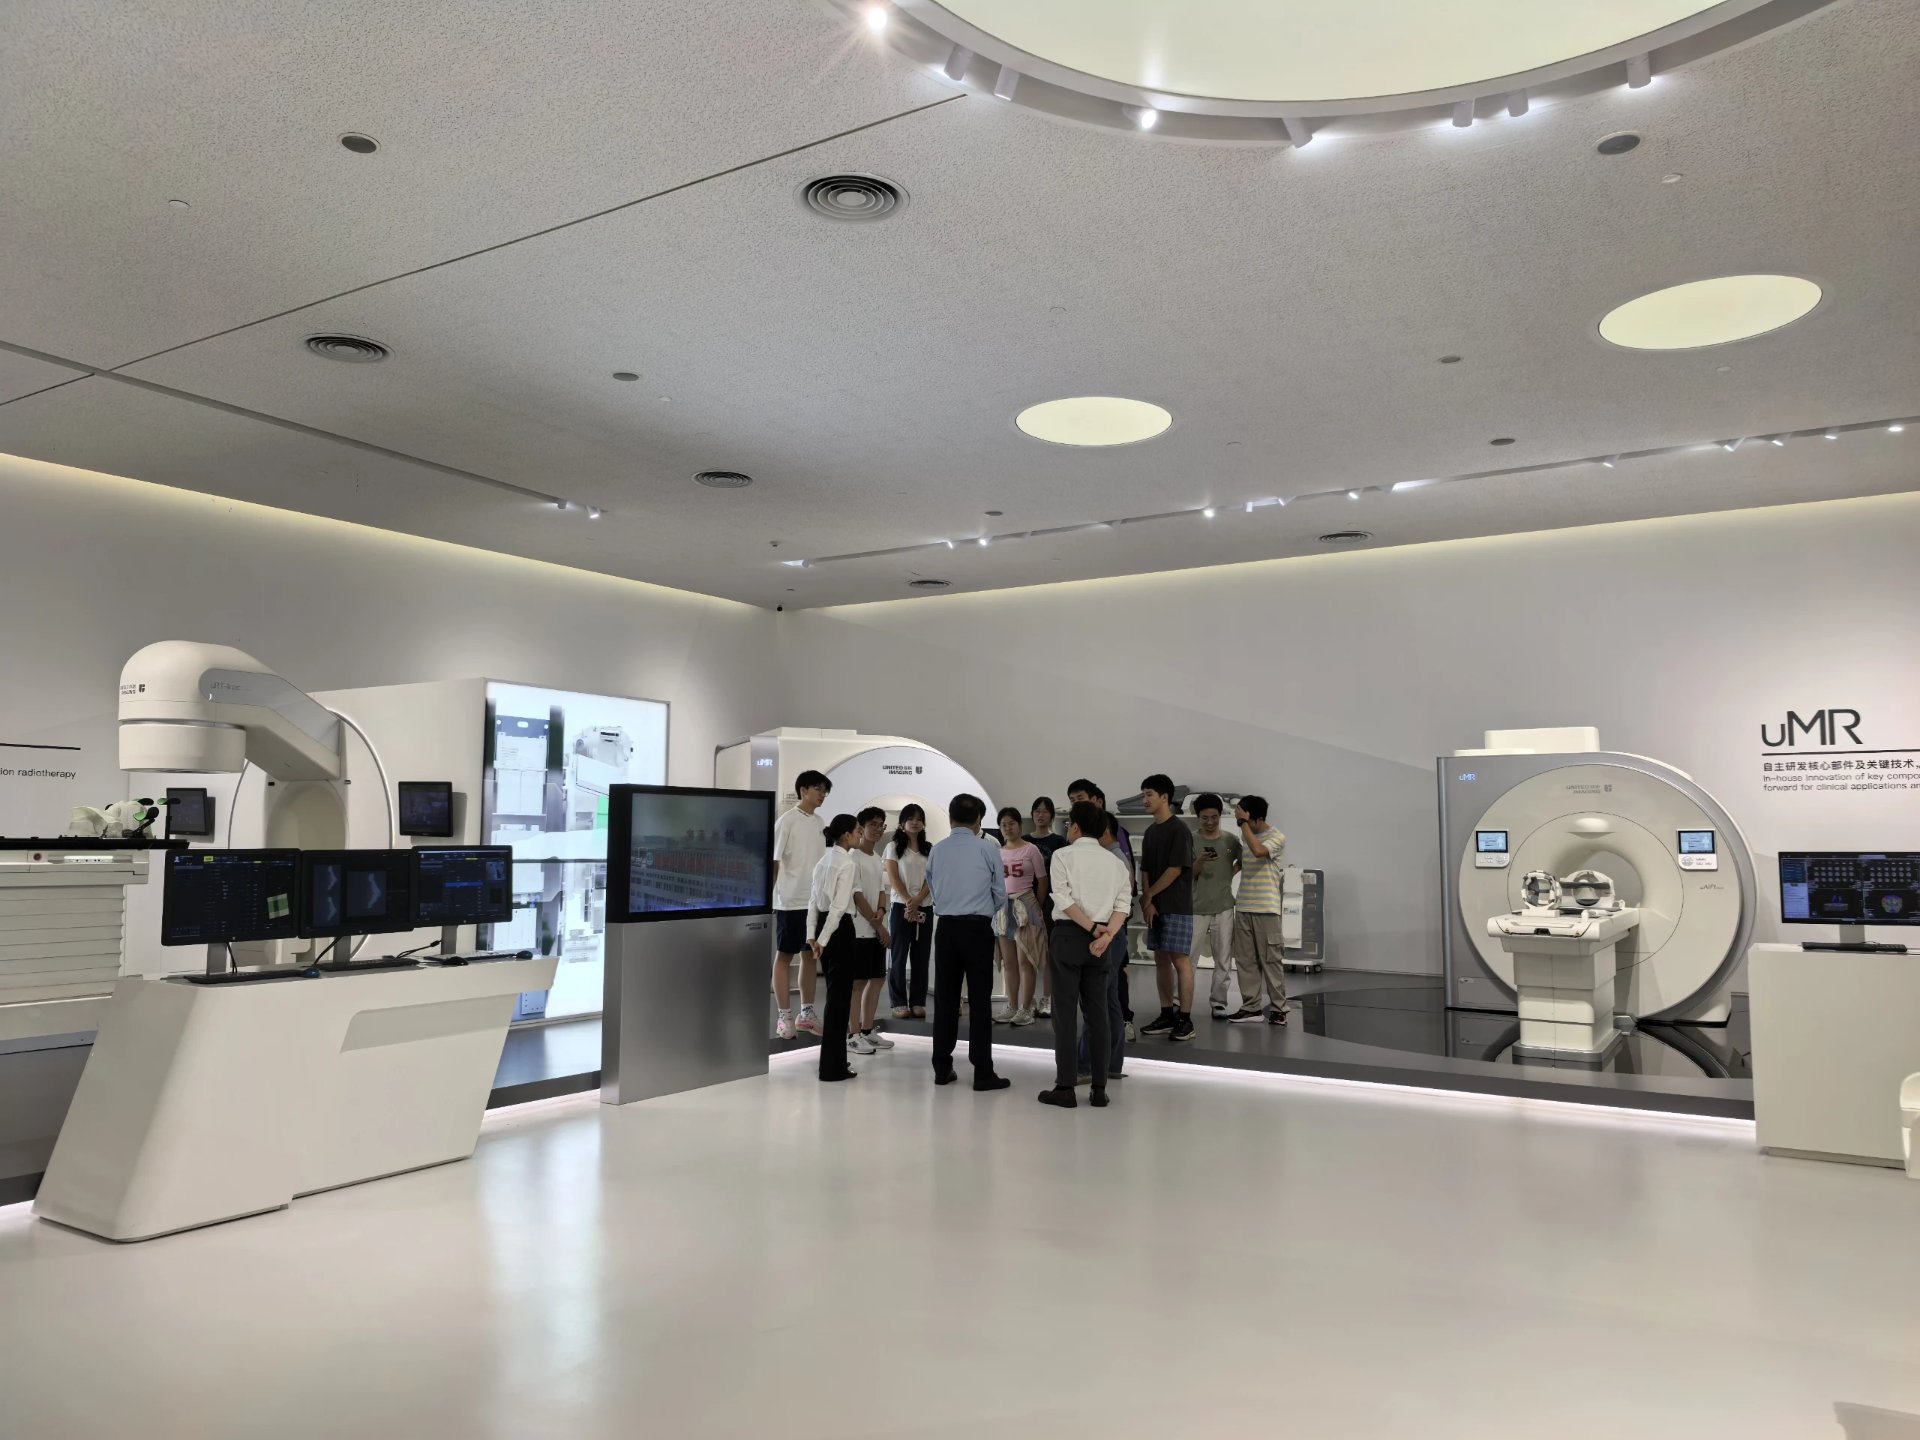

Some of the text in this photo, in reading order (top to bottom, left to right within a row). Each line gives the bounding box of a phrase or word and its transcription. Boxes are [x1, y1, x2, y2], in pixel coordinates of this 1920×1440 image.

[1761, 709, 1864, 747] uMR
[17, 769, 76, 780] radiotherapy
[1459, 773, 1476, 781] uMR
[1806, 773, 1852, 781] innovation
[1855, 772, 1865, 780] of
[1868, 773, 1884, 781] key
[1763, 784, 1798, 792] forward
[1816, 783, 1847, 791] clinical
[1851, 782, 1907, 791] applications
